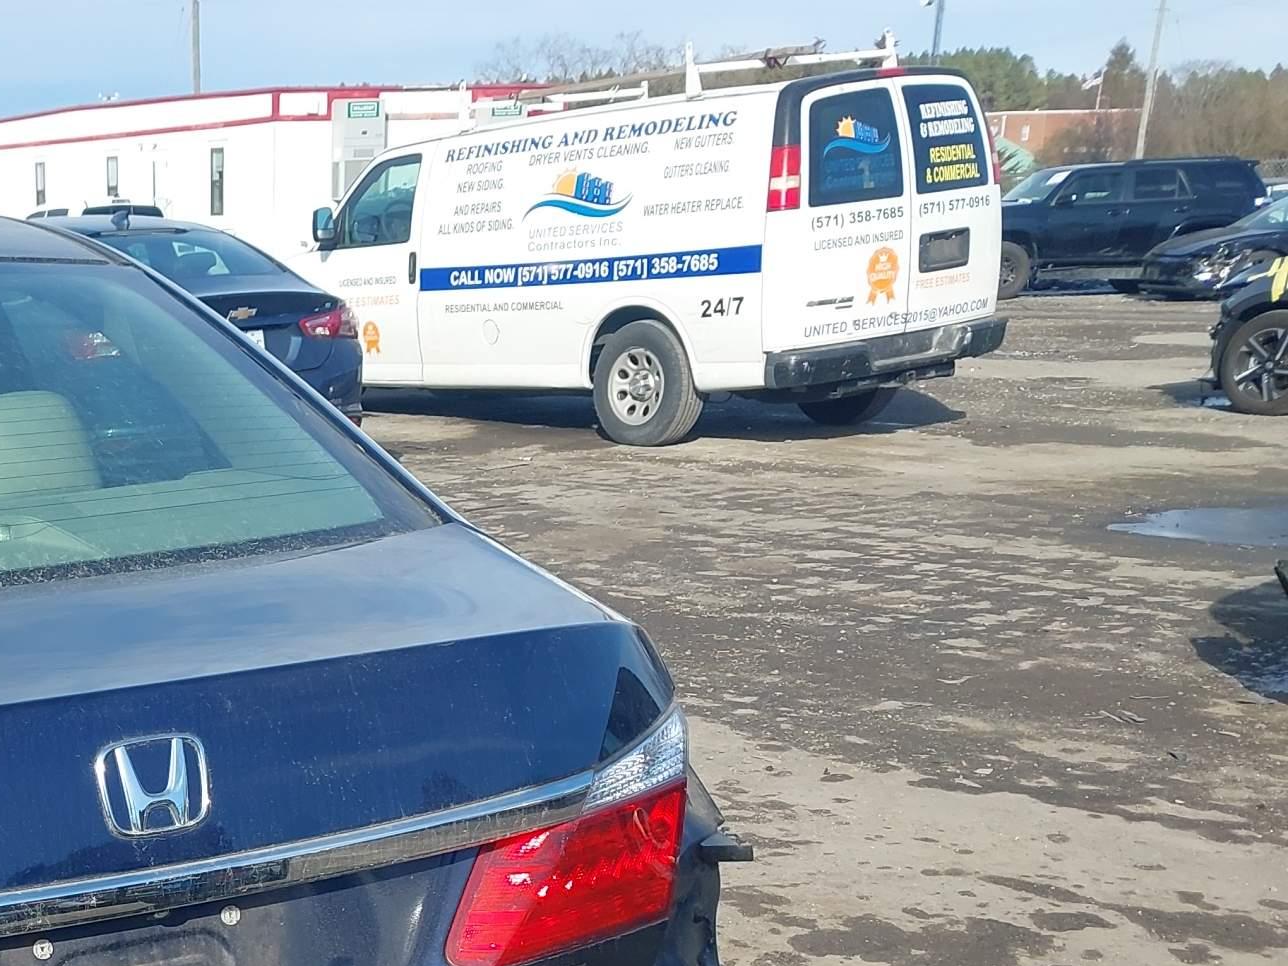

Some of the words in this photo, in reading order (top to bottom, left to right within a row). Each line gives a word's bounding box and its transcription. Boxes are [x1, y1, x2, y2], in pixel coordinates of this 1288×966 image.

[445, 135, 554, 163] REFINISHING
[557, 128, 598, 148] AND
[603, 110, 737, 142] REMODELING
[674, 136, 693, 151] NEW
[529, 150, 561, 166] DRYER
[563, 147, 594, 163] VENTS
[597, 141, 650, 159] CLEANING.
[929, 144, 976, 163] RESIDENTIAL
[466, 160, 503, 175] ROOFING
[664, 164, 694, 179] GUTTERS
[926, 168, 933, 184] &
[934, 163, 980, 182] COMMERCIAL
[457, 181, 475, 193] NEW
[454, 205, 469, 216] AND
[470, 201, 502, 214] REPAIRS
[643, 203, 669, 217] WATER
[670, 200, 702, 214] HEATER
[919, 200, 946, 217] (571)
[948, 195, 990, 212] 577-0916
[811, 214, 845, 231] (571)
[849, 206, 904, 224] 358-7685
[437, 224, 451, 235] ALL
[452, 221, 475, 234] KINDS
[476, 220, 486, 232] OF
[529, 225, 567, 239] UNITED
[569, 221, 623, 236] SERVICES
[528, 238, 595, 252] Contractors
[599, 237, 621, 247] Inc.
[814, 236, 853, 251] LICENSED
[854, 232, 871, 246] AND
[872, 229, 904, 243] INSURED
[450, 269, 481, 286] CALL
[484, 267, 515, 285] NOW
[550, 261, 609, 281] 577-0916
[651, 253, 719, 275] 358-7685
[915, 276, 934, 289] FREE
[935, 272, 970, 288] ESTIMATES
[445, 302, 491, 313] RESIDENTIAL
[493, 301, 509, 312] AND
[510, 300, 564, 311] COMMERCIAL
[700, 296, 745, 318] 24/7
